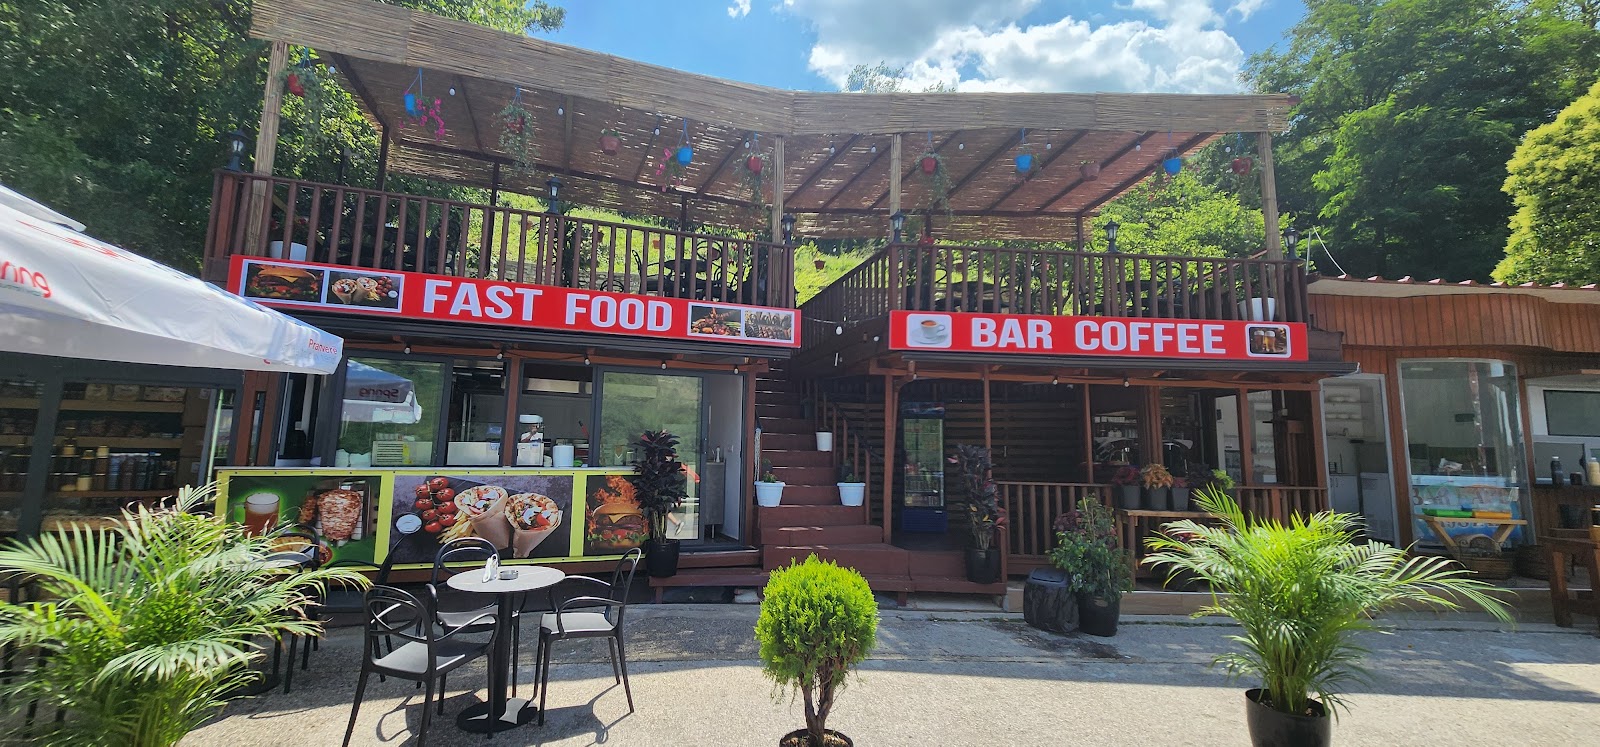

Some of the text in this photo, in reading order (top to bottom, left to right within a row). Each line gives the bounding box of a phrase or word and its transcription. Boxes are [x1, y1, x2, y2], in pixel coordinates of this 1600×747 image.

[0, 261, 51, 298] ring
[423, 278, 673, 332] FAST FOOD
[971, 317, 1226, 354] BAR COFFEE
